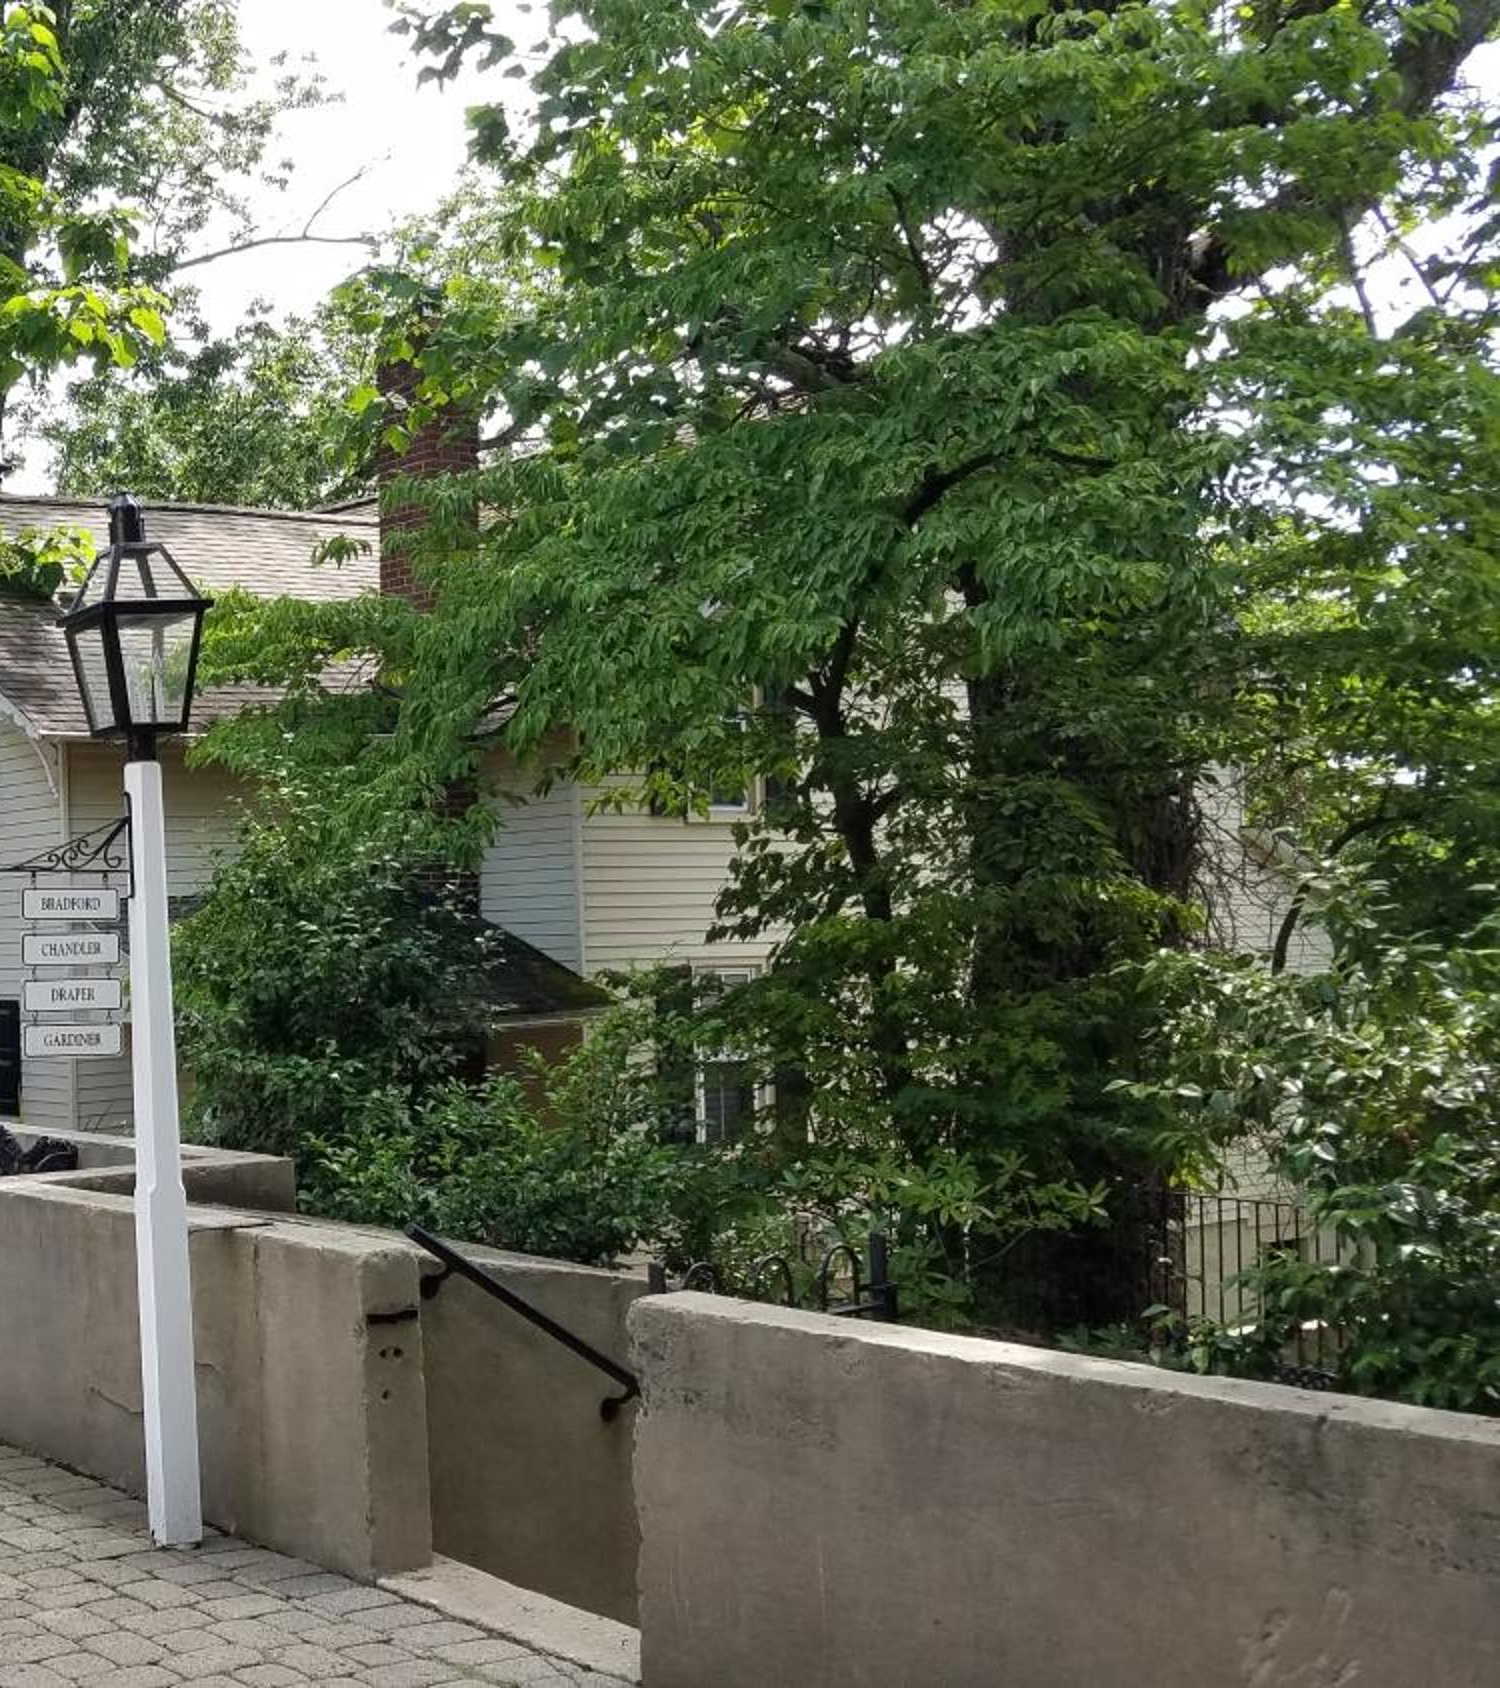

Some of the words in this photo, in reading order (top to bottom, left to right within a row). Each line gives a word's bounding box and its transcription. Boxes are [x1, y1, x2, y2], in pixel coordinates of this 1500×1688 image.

[41, 897, 101, 911] BRADFORD
[41, 941, 102, 957] CHANDLER
[51, 986, 96, 1002] DRAPER
[43, 1031, 102, 1048] GARDINER
